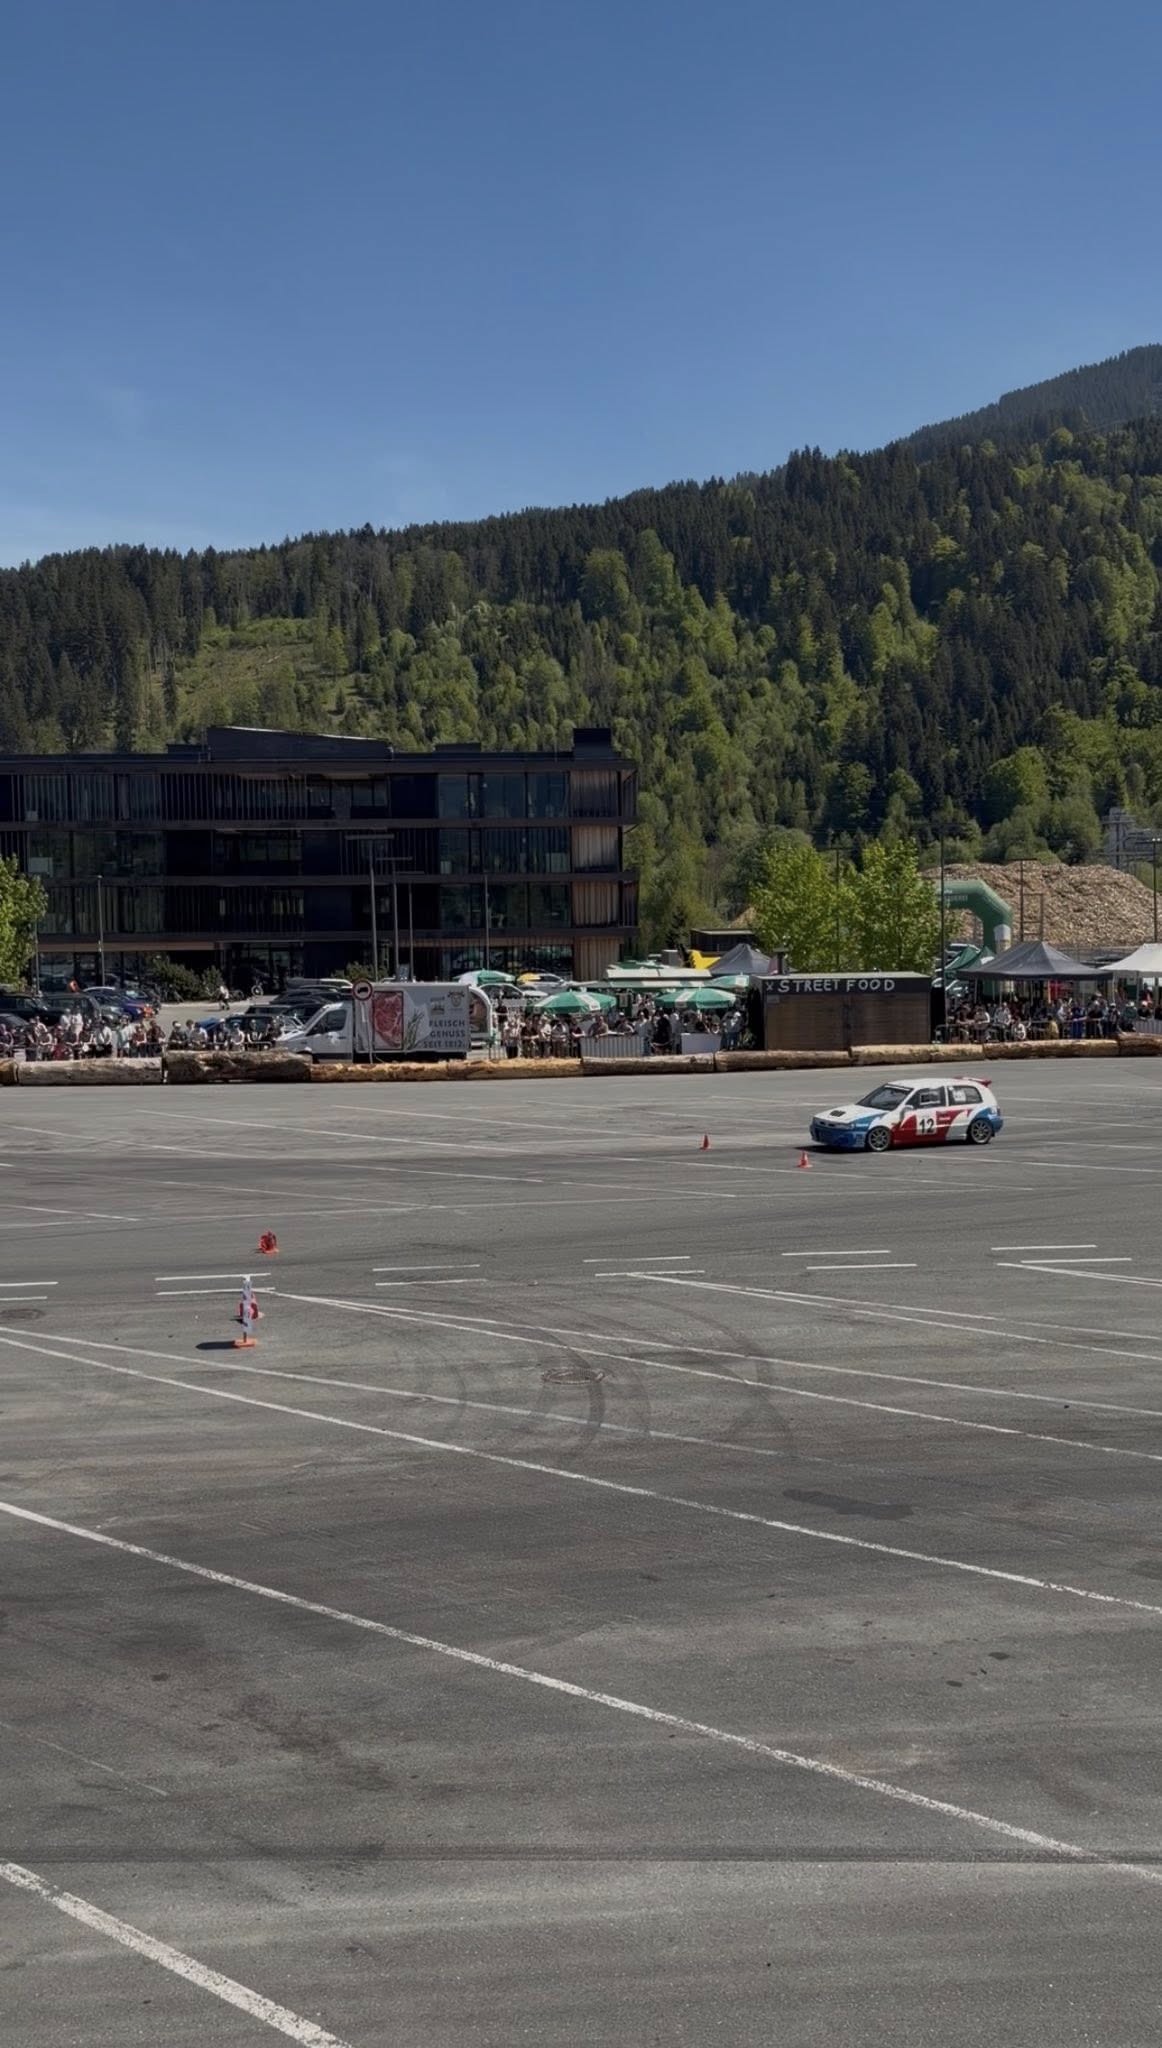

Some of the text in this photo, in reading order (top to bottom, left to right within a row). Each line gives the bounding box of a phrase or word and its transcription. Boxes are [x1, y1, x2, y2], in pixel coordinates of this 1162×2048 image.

[778, 980, 840, 992] STREET
[846, 979, 895, 992] FOOD
[430, 1029, 465, 1038] GENUSS
[919, 1117, 935, 1134] 12
